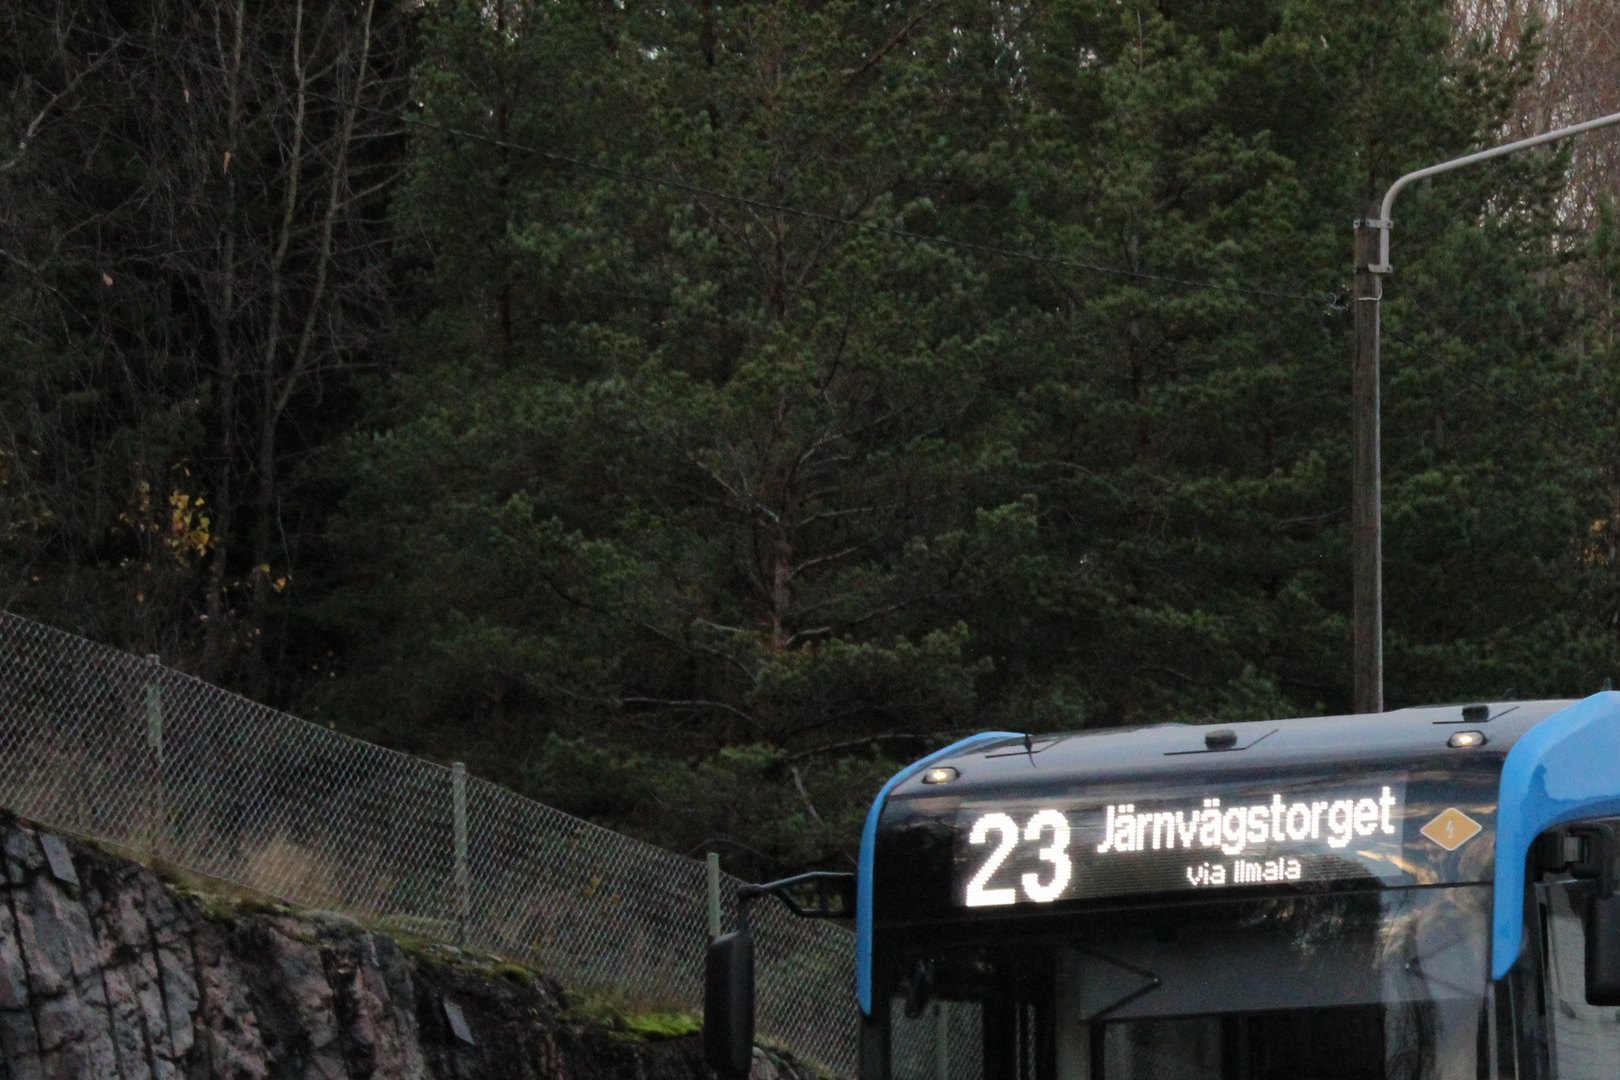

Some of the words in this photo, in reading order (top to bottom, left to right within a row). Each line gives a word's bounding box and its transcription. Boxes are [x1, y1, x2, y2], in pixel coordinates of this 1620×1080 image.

[1097, 786, 1396, 855] Järnvägstorget
[965, 808, 1073, 907] 23
[1186, 862, 1226, 886] via
[1233, 858, 1302, 883] Ilmala
